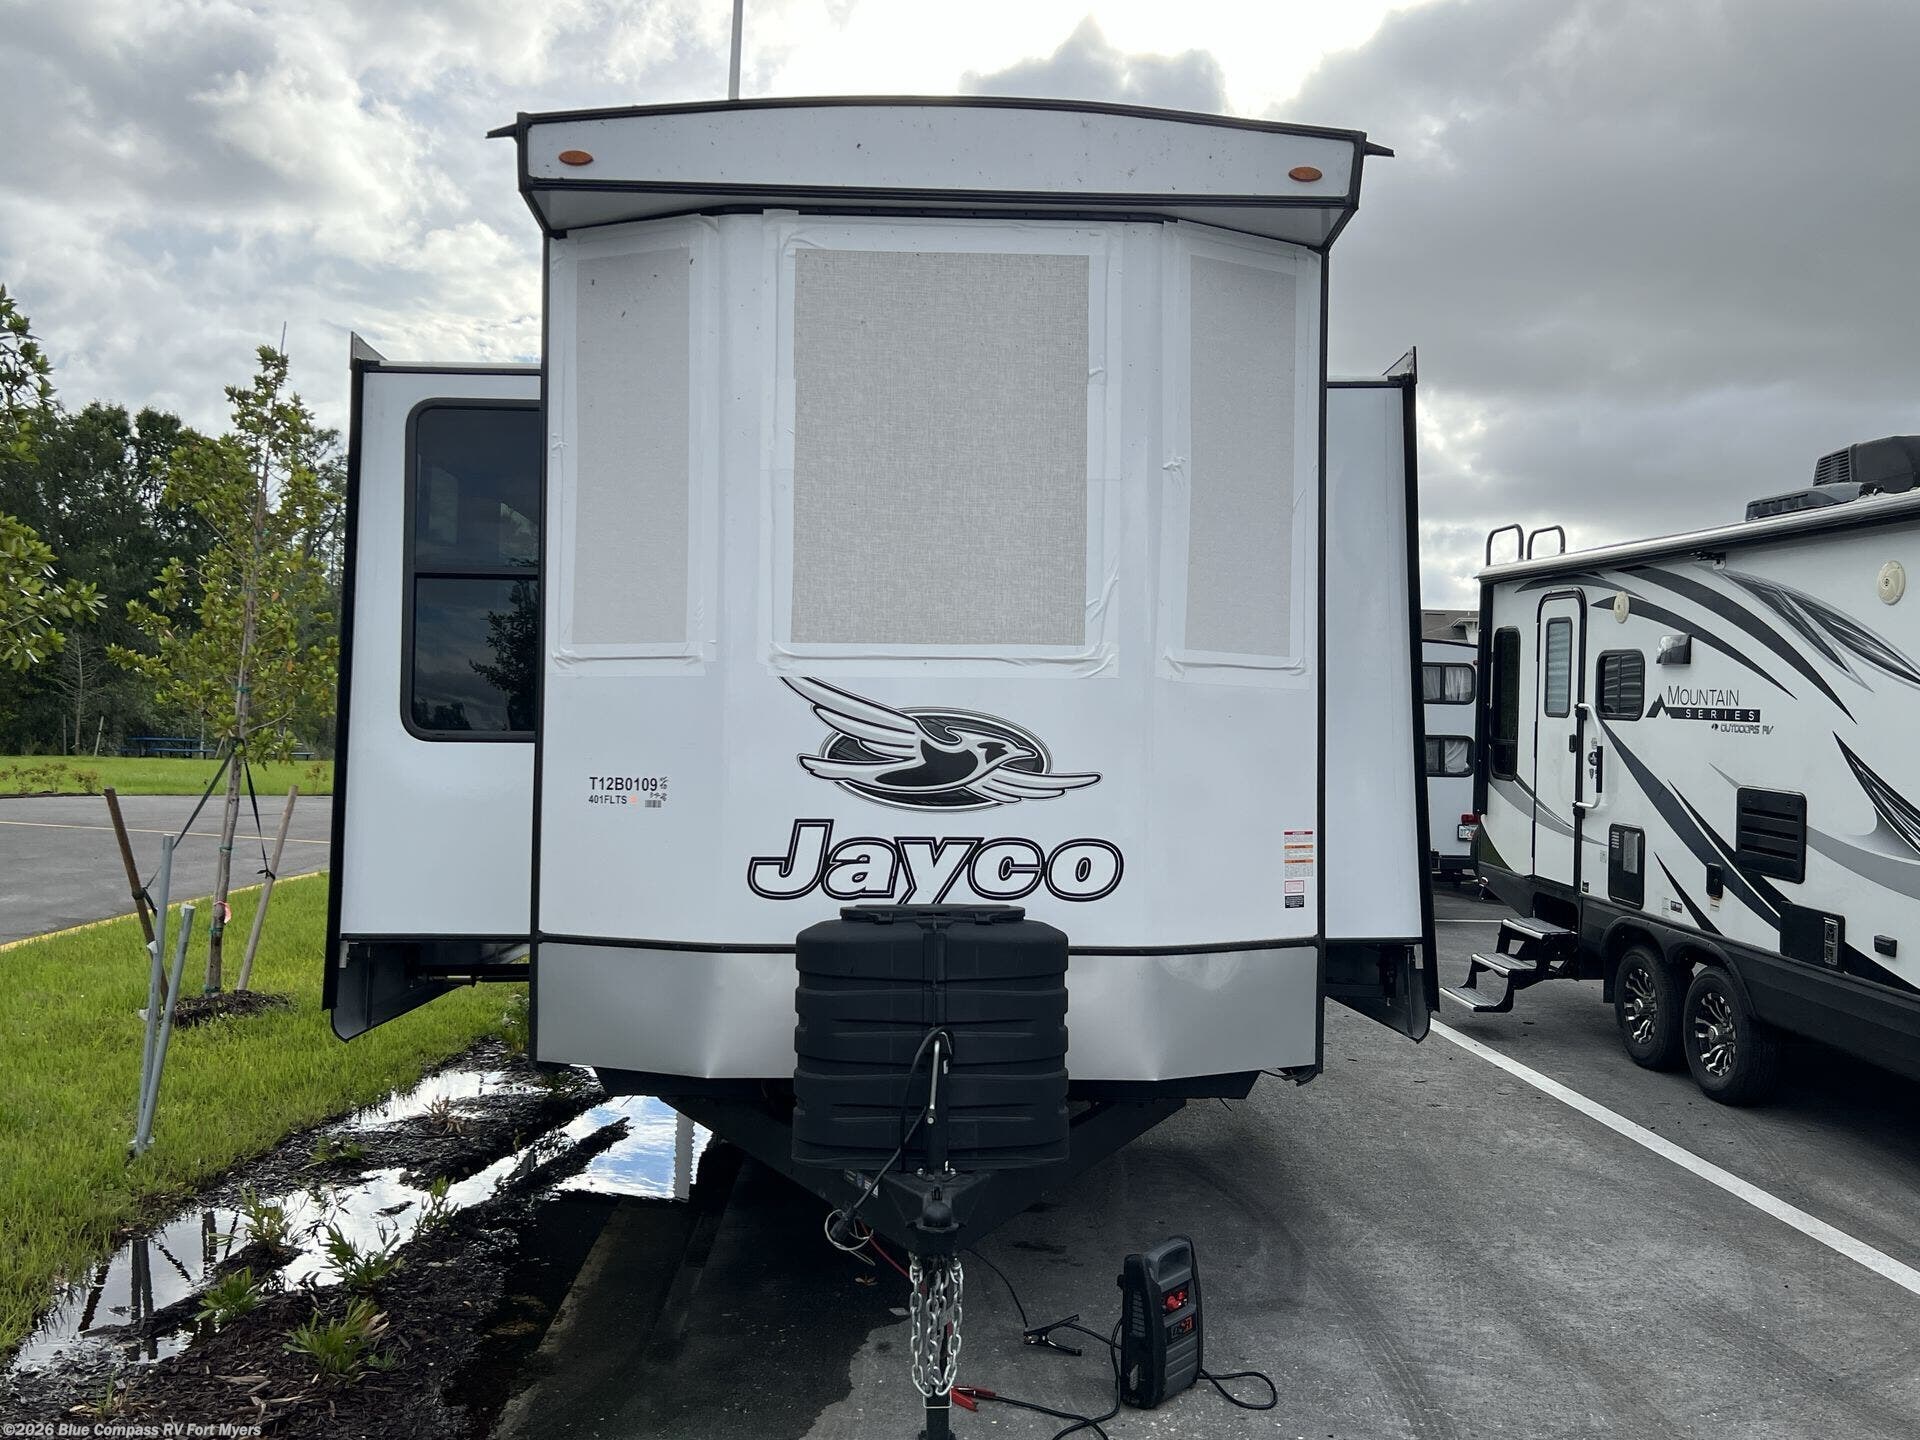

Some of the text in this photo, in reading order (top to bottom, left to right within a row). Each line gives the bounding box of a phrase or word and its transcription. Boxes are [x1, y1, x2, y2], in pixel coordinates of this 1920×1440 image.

[1667, 685, 1740, 706] MOUNTAIN
[1685, 708, 1755, 721] SERIES
[1720, 723, 1760, 735] OUTDOORS
[589, 776, 658, 791] T12B0109
[588, 794, 628, 805] 401FLTS
[747, 818, 1124, 905] Jayco
